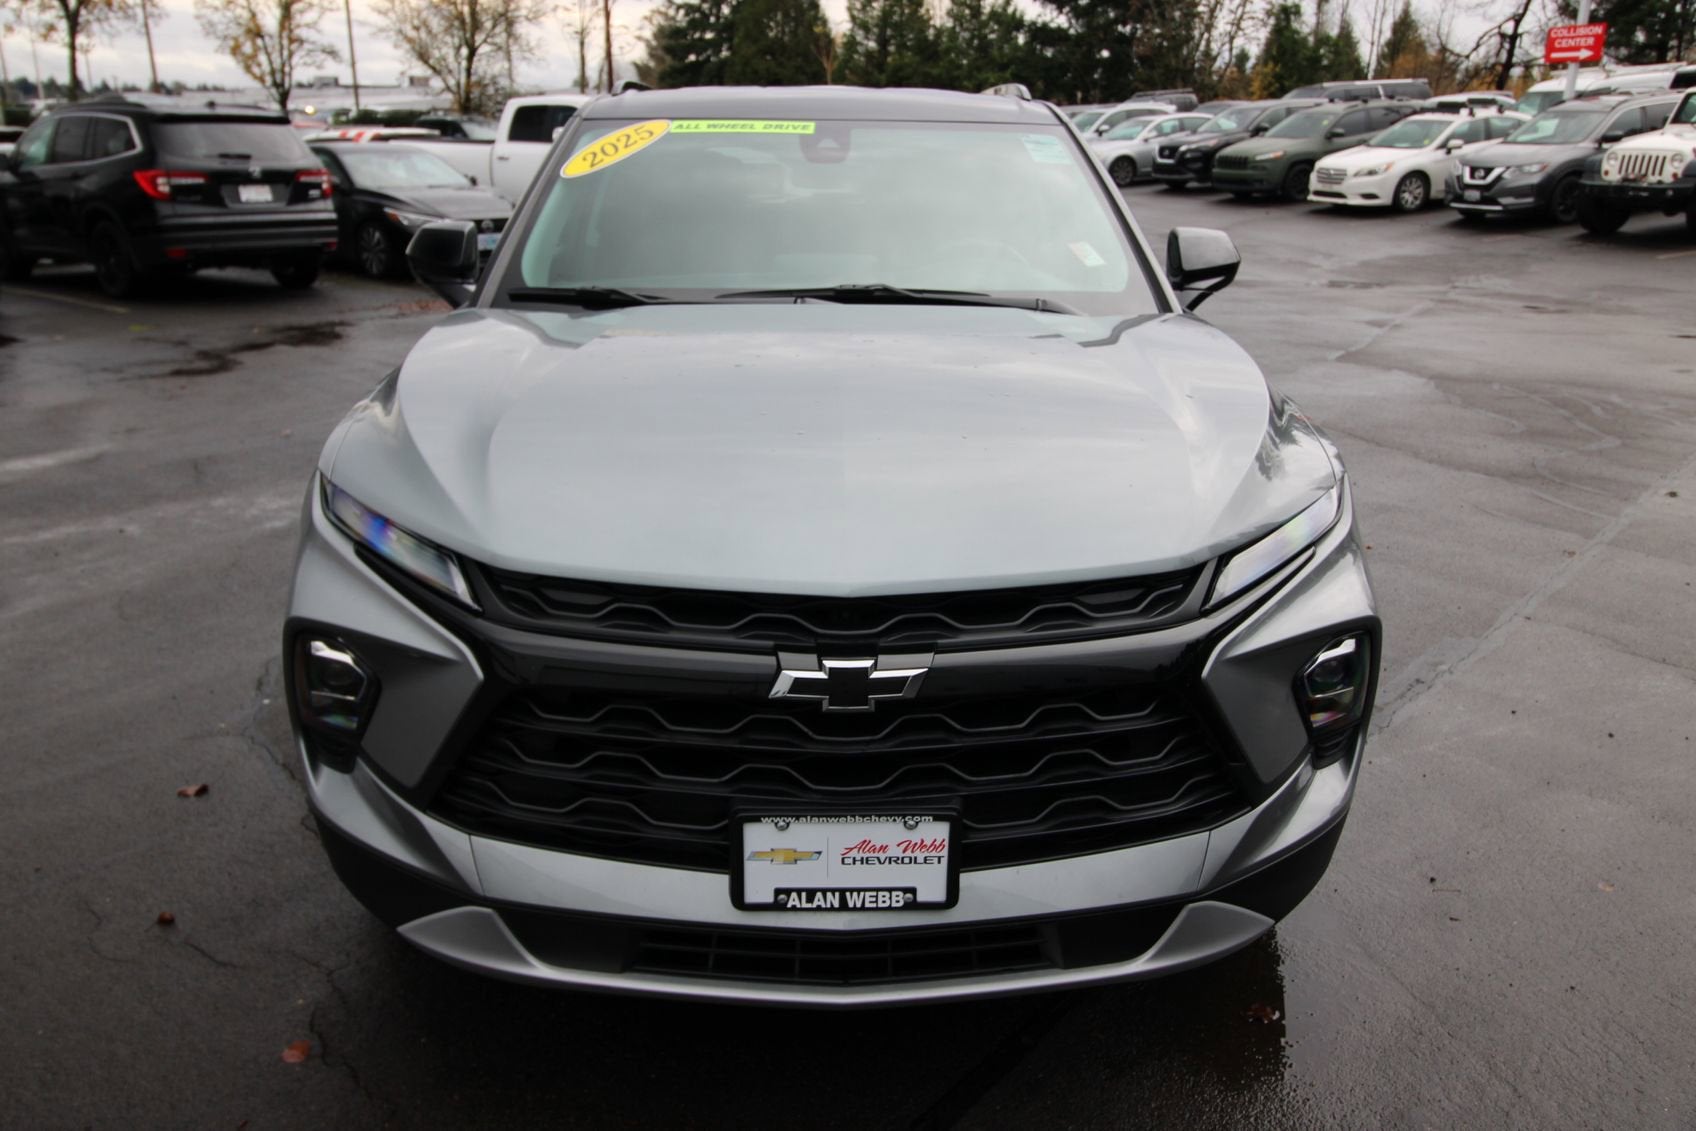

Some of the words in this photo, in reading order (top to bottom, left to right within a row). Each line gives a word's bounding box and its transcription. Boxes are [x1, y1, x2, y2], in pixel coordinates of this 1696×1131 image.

[1551, 24, 1603, 38] COLLISION
[1554, 36, 1595, 48] CENTER
[674, 122, 702, 131] ALL
[706, 122, 756, 131] WHEEL
[761, 123, 812, 132] DRIVE
[581, 125, 655, 168] 2025
[760, 814, 934, 824] www.alanwebbchevy.com
[840, 839, 890, 857] Alan
[896, 838, 946, 855] Webb
[840, 855, 945, 866] CHEVROLET
[786, 891, 840, 909] ALAN
[845, 890, 905, 908] WEBB
